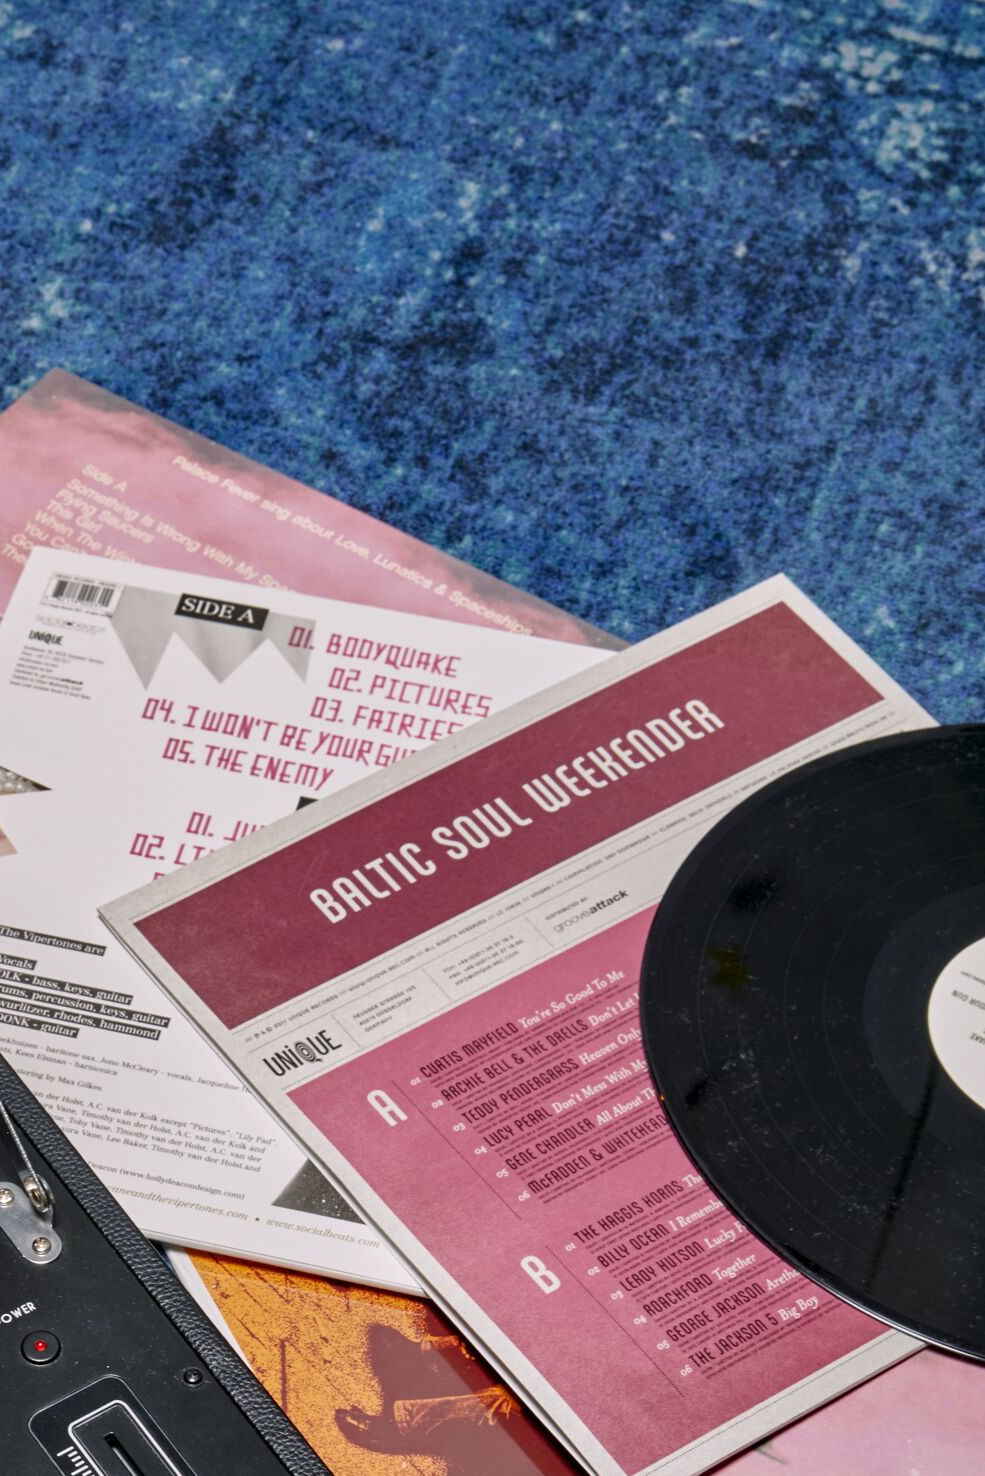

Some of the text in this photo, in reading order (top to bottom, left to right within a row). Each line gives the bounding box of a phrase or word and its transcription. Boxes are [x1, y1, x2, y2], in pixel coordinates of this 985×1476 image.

[82, 464, 128, 494] Side A
[46, 499, 102, 533] This Girl
[53, 488, 154, 543] Flying Saucers
[67, 478, 259, 583] Something Wrong With My
[219, 475, 258, 502] Fever
[260, 496, 289, 521] sing
[291, 515, 334, 539] about
[373, 552, 432, 589] Lunatics
[181, 597, 254, 623] SIDE A
[326, 633, 459, 677] BODYQUAKE
[309, 696, 342, 722] 03.
[327, 666, 491, 717] 02. PICTURES
[205, 744, 333, 790] THE ENEMY
[279, 724, 311, 751] BE
[311, 731, 372, 765] YOUR
[310, 843, 437, 925] BALTIC
[431, 796, 531, 862] SOUL
[522, 698, 725, 813] WEEKENDER
[20, 930, 83, 953] Vipertones
[83, 945, 104, 956] are
[31, 974, 61, 991] bass,
[95, 988, 132, 1006] guitar
[31, 990, 97, 1014] percussion,
[131, 1010, 168, 1028] guitar
[39, 1020, 77, 1038] guitar
[99, 1017, 158, 1038] hammond
[419, 966, 626, 1077] CURTIS MAYFIELD You're So Good To Me
[440, 994, 636, 1101] ARCHIE BELL & THE DRELLS Don't Let
[57, 1075, 74, 1085] Max
[460, 1024, 645, 1123] TEDDY PENDERGRASS Heaven Only
[81, 1109, 113, 1123] Timothy
[366, 1089, 408, 1127] A
[482, 1055, 651, 1147] LUCY PEARL Don't Mess With My
[504, 1095, 643, 1170] GENE CHANDLER All About
[589, 1148, 604, 1161] &
[602, 1113, 669, 1154] WHITEHEAD
[572, 1180, 683, 1243] THE HAGGIS HORNS
[596, 1223, 669, 1267] BILLY OCEAN
[619, 1224, 738, 1291] LEROY HUTSON Lucky
[520, 1255, 561, 1295] B
[643, 1254, 755, 1316] ROACHFORD Together
[665, 1282, 765, 1341] GEORGE JACKSON
[687, 1291, 821, 1367] THE JACKSON 5 Big Boy
